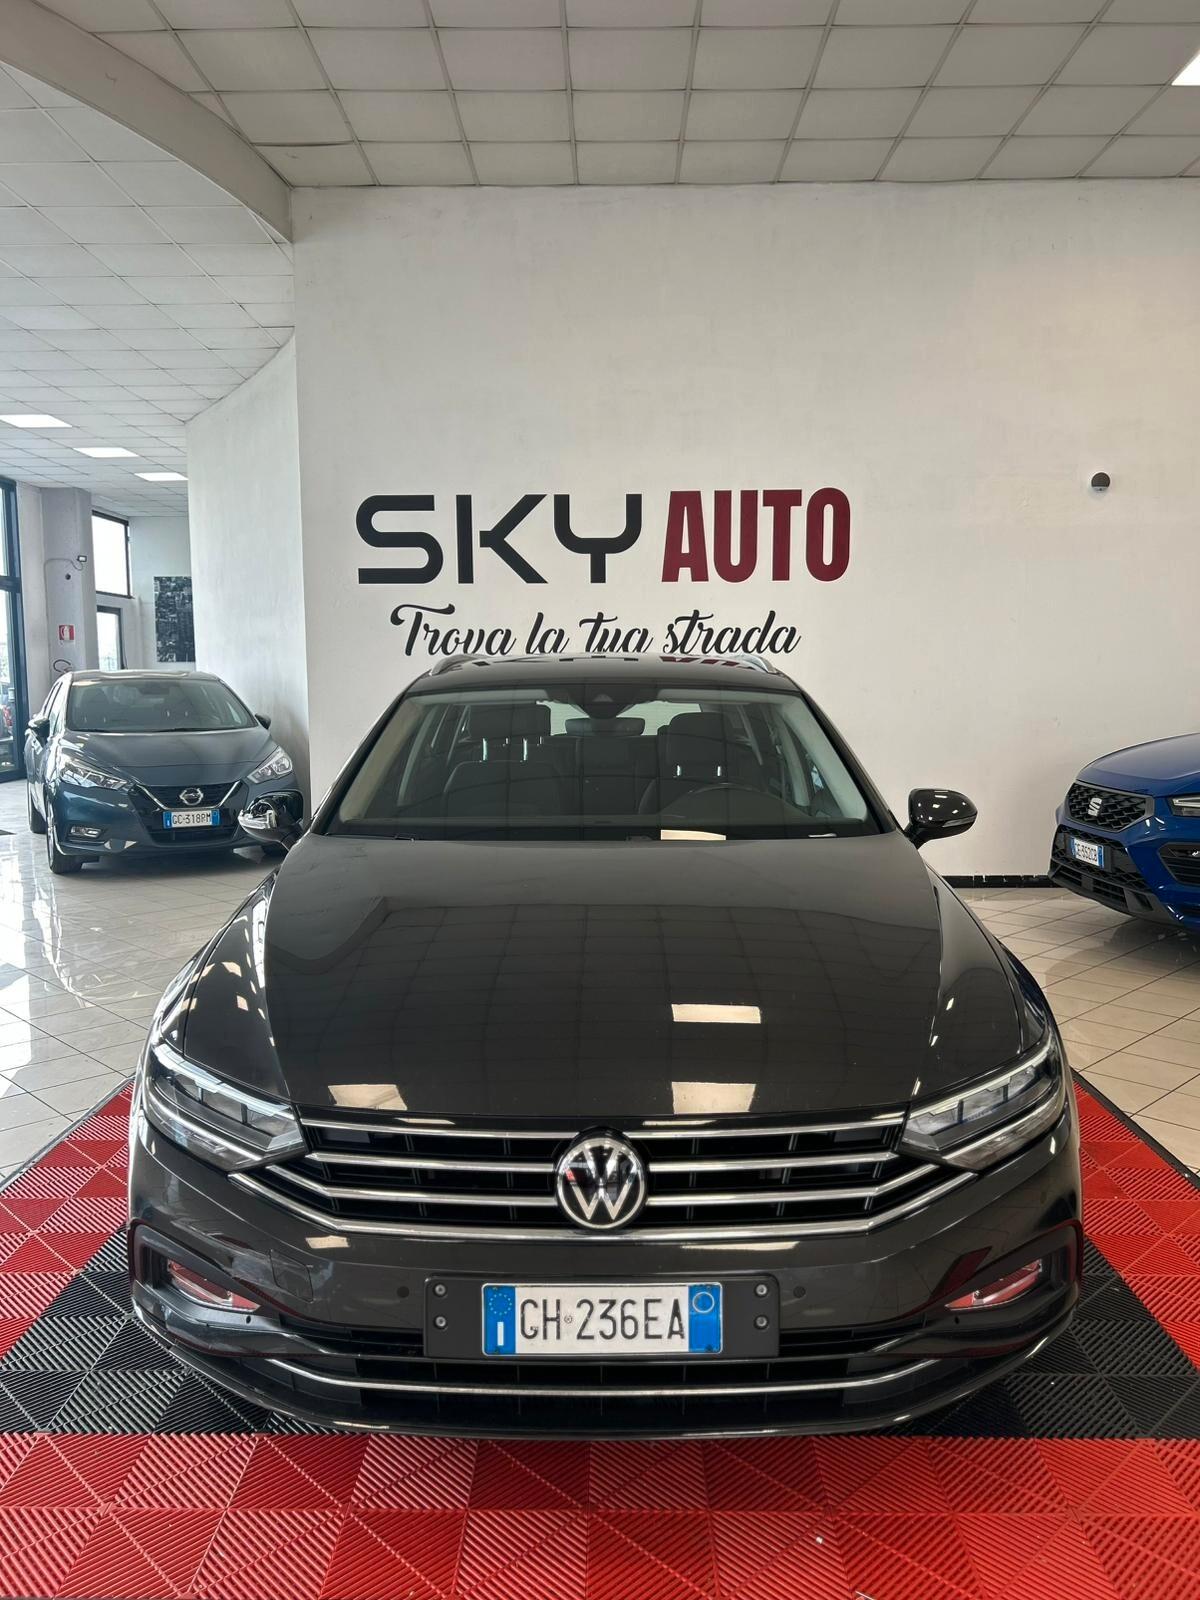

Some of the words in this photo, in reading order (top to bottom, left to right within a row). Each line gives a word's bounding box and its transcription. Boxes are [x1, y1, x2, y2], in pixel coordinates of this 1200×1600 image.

[356, 493, 643, 584] SKY
[661, 487, 851, 583] AUTO
[390, 603, 517, 656] Trova
[525, 611, 570, 654] la
[579, 611, 653, 653] tua
[663, 609, 801, 654] strada
